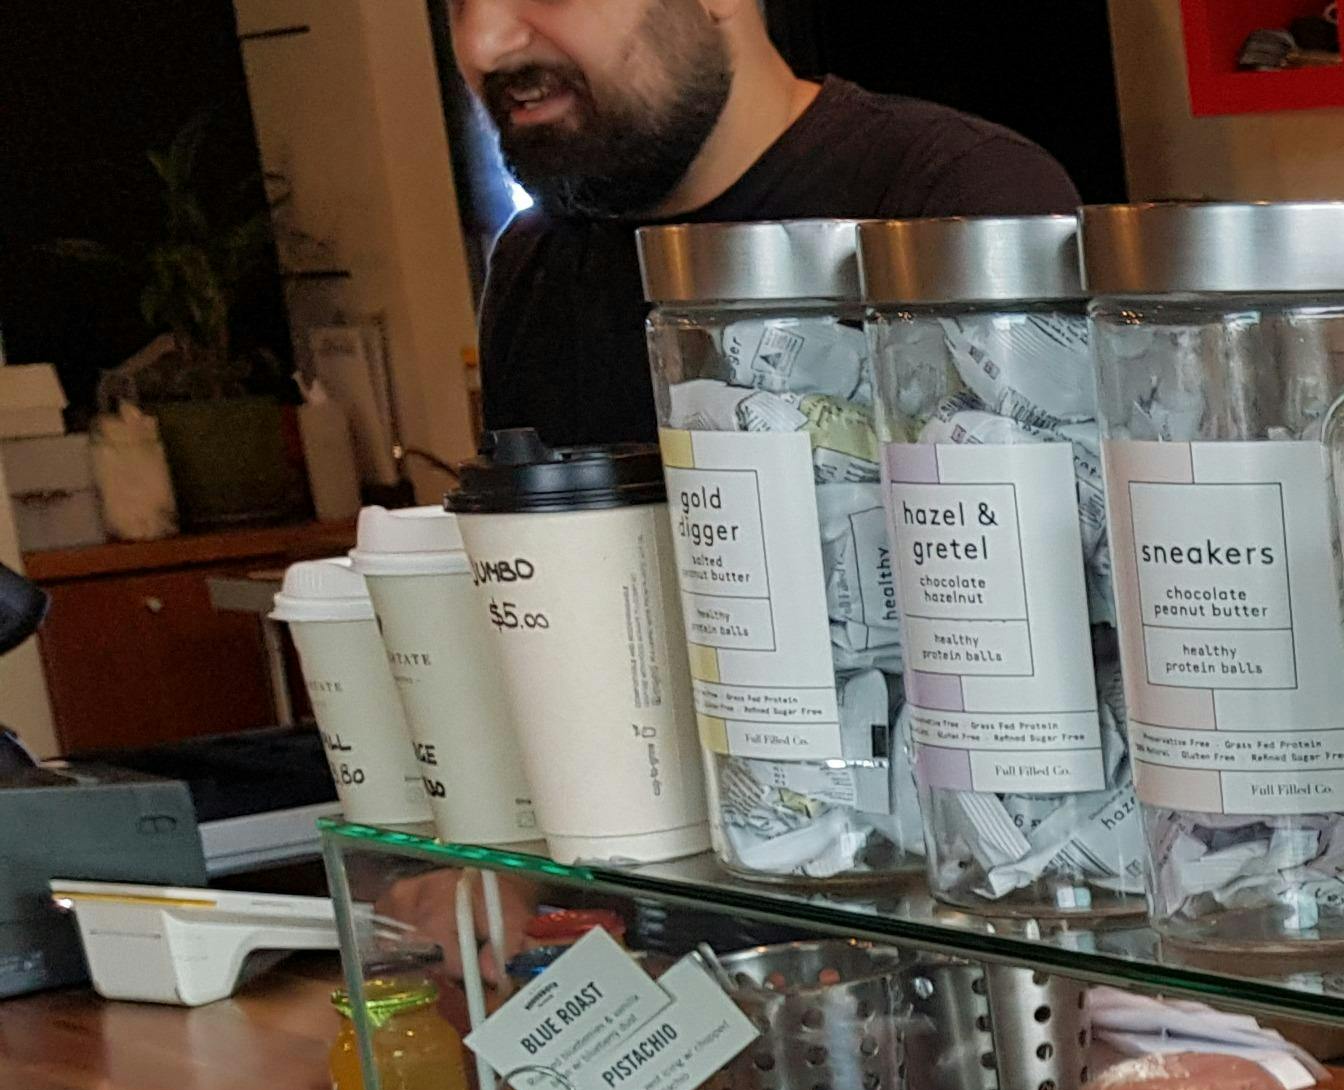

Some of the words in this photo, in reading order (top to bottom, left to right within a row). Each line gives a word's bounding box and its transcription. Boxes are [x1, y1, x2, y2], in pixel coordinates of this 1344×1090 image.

[681, 486, 722, 514] gold
[903, 501, 965, 526] hazel
[978, 502, 999, 526] &
[679, 518, 739, 546] digger
[913, 535, 988, 565] gretel
[1142, 539, 1274, 565] sneakers
[474, 559, 534, 586] JUMBO
[711, 569, 751, 583] butter
[920, 575, 986, 588] chocolate
[924, 591, 984, 604] hazelnut
[1166, 585, 1247, 601] chocolate
[489, 597, 549, 634] $5.00
[1154, 604, 1206, 618] peanut
[1212, 604, 1268, 618] butter
[934, 634, 979, 648] healthy
[922, 650, 961, 661] protein
[965, 650, 1003, 662] balls
[1183, 645, 1237, 660] healthy
[1166, 662, 1216, 674] protein
[1221, 661, 1263, 675] balls
[995, 764, 1016, 777] Full
[1018, 765, 1050, 777] Filled
[1251, 784, 1274, 797] Full
[1278, 783, 1311, 797] Filled
[520, 1017, 561, 1054] BLUE
[555, 982, 603, 1025] ROAST
[601, 1023, 678, 1087] PISTACHIO
